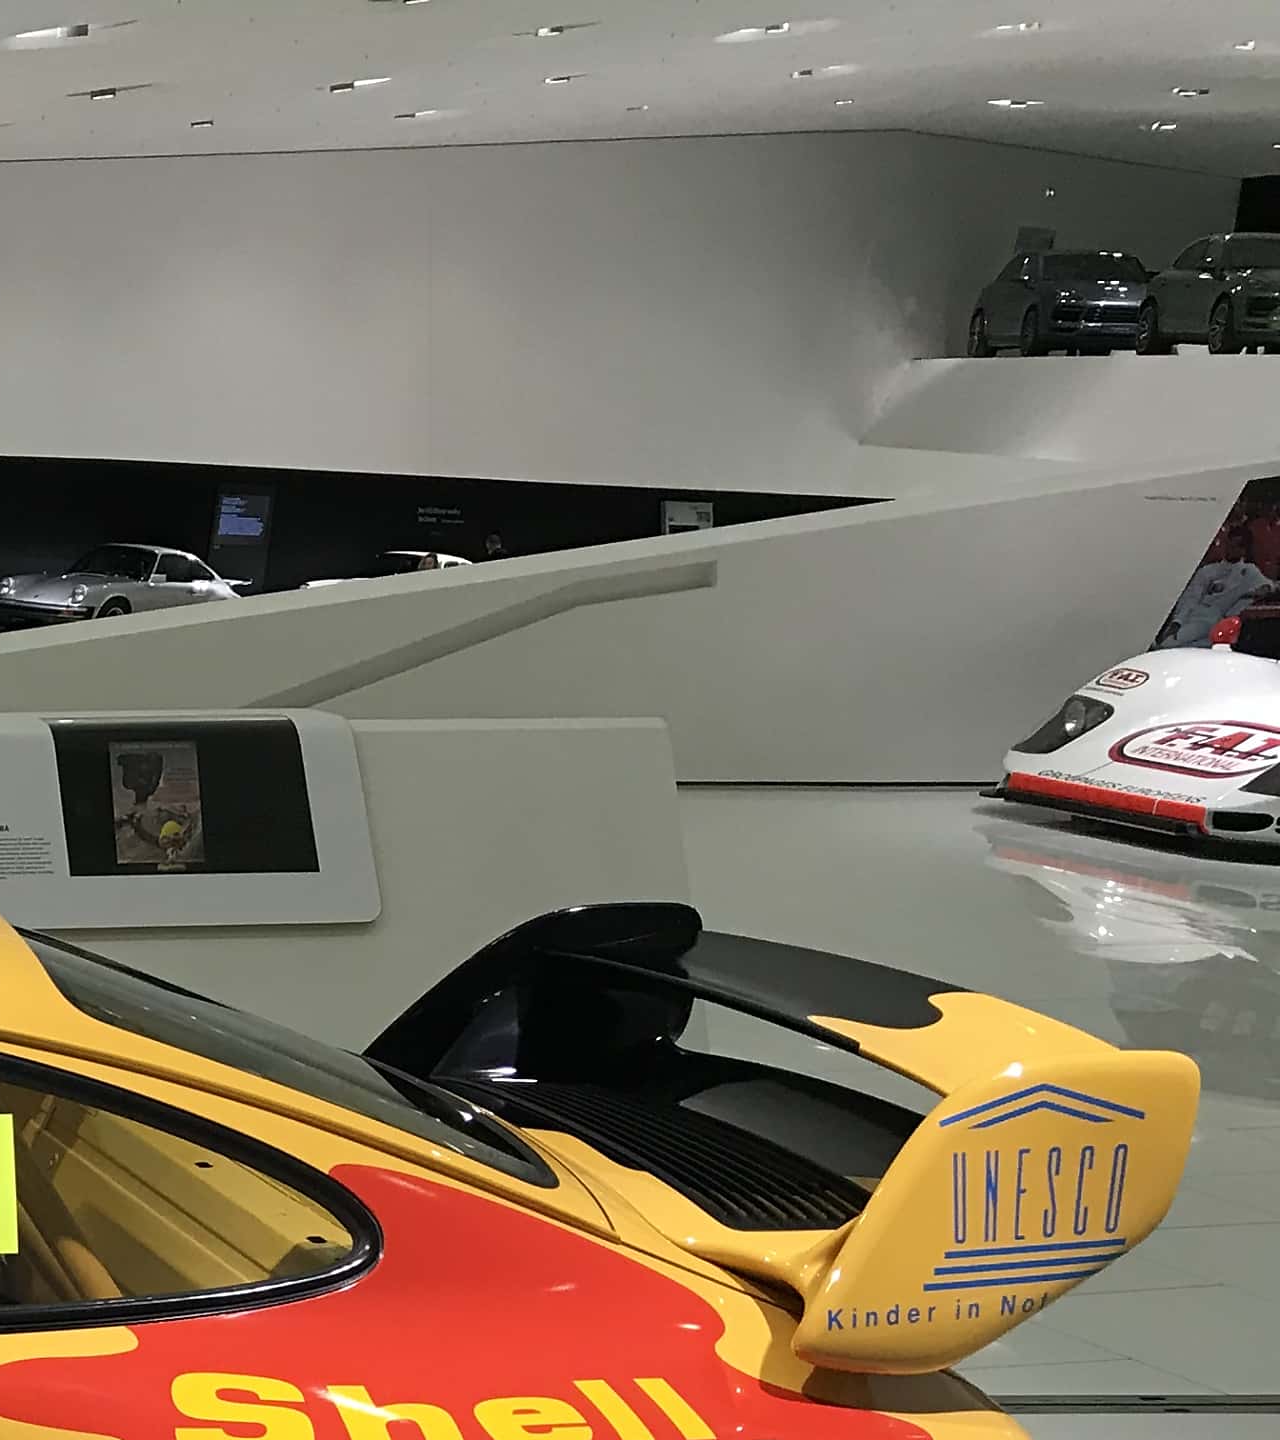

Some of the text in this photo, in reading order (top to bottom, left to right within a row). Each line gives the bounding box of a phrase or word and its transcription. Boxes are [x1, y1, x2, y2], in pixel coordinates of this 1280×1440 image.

[952, 1143, 1129, 1245] UNESCO
[827, 1293, 1051, 1332] Kinder in Not
